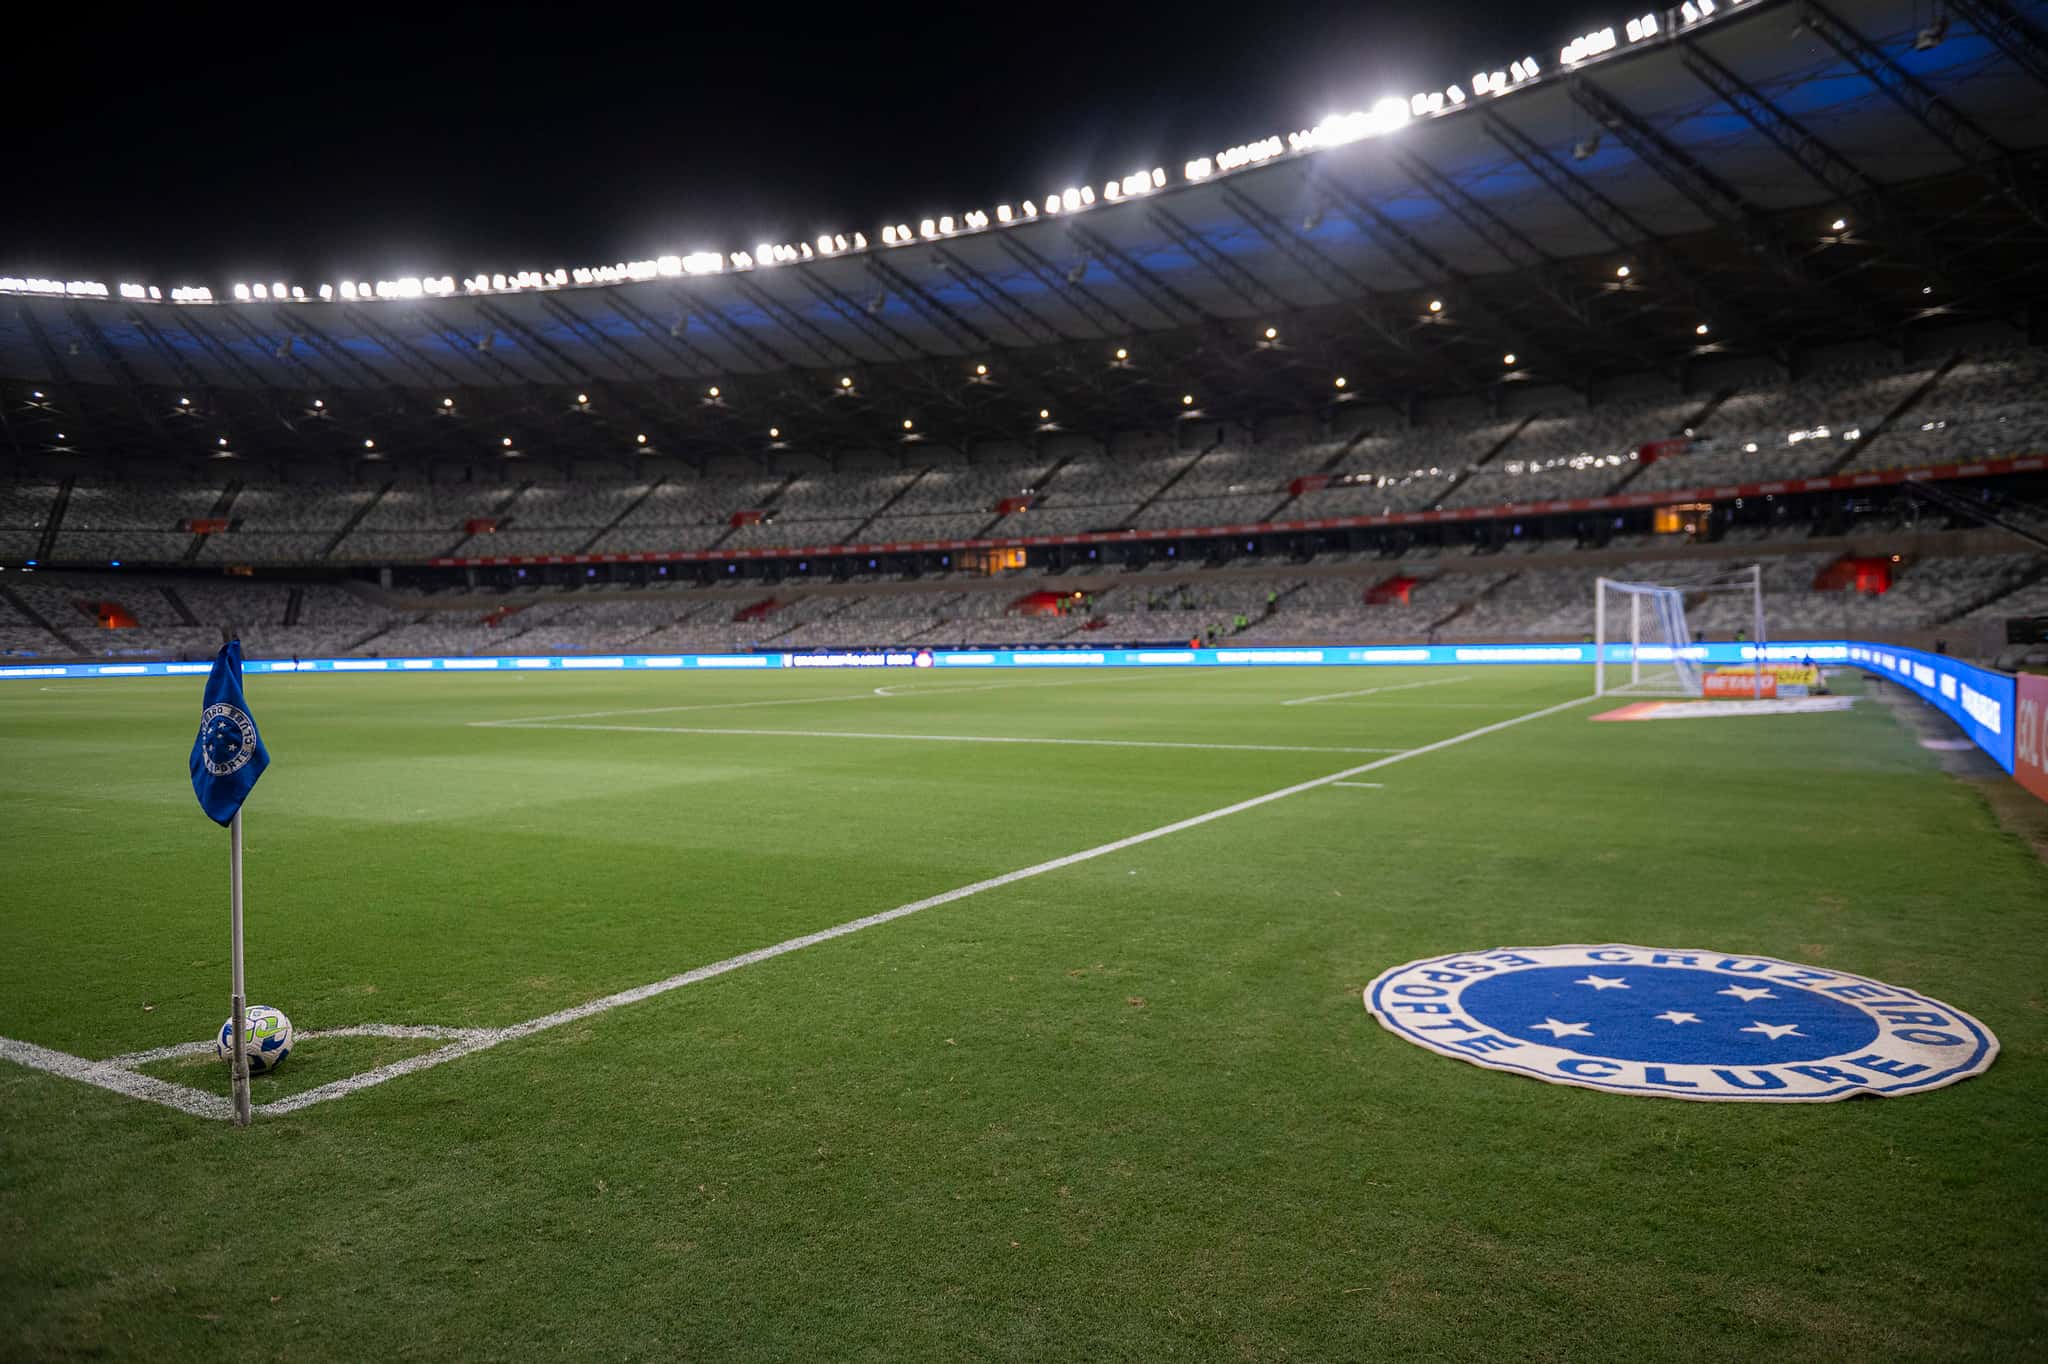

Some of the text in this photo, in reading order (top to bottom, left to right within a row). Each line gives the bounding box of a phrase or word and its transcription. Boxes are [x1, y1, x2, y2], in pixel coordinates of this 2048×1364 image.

[1392, 954, 1932, 1089] ESPORTE CLUBE
[1586, 951, 1966, 1046] CRUZEIRO
